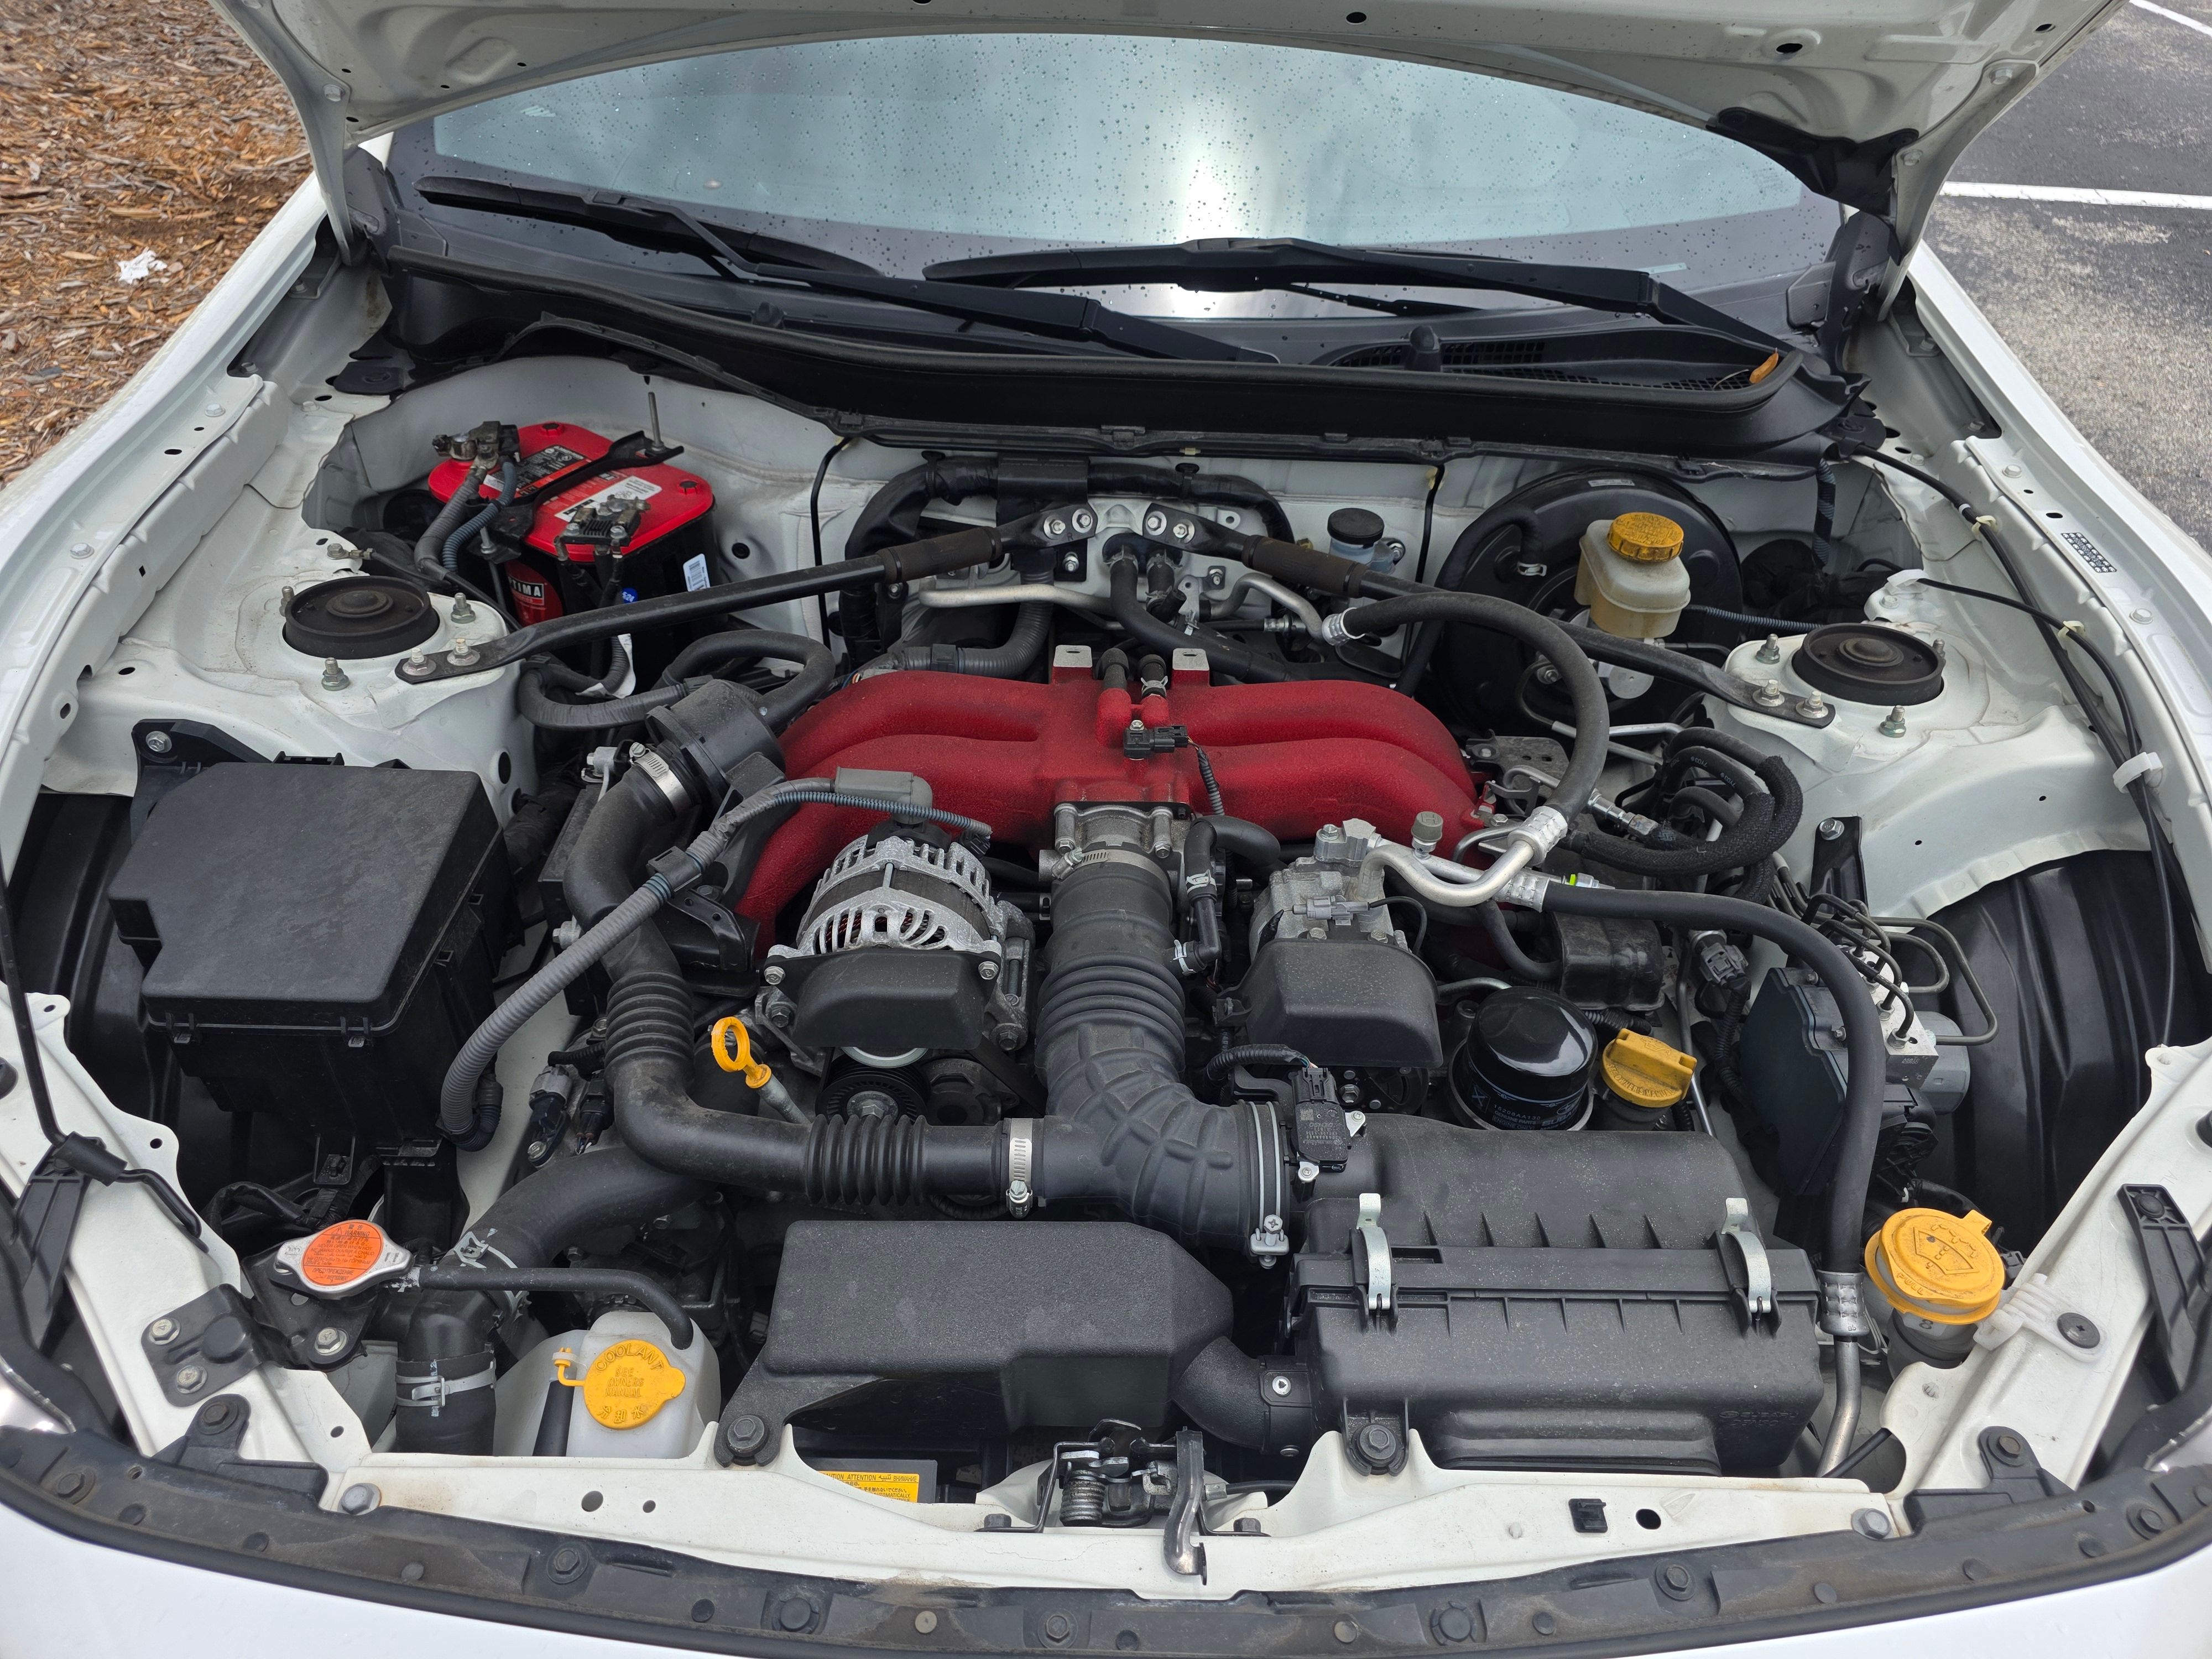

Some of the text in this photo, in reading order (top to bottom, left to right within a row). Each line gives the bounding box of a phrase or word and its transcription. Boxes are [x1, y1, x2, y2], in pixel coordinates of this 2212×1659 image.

[508, 576, 541, 597] TIMA
[1607, 1064, 1676, 1098] SEE OWNER'S MANUAL
[1494, 1110, 1517, 1123] GENUINE
[1897, 1272, 1923, 1296] PULL
[595, 1343, 664, 1371] COOLANT
[615, 1367, 634, 1377] SEE
[608, 1378, 644, 1387] OWNERS
[605, 1388, 641, 1397] MANUAL
